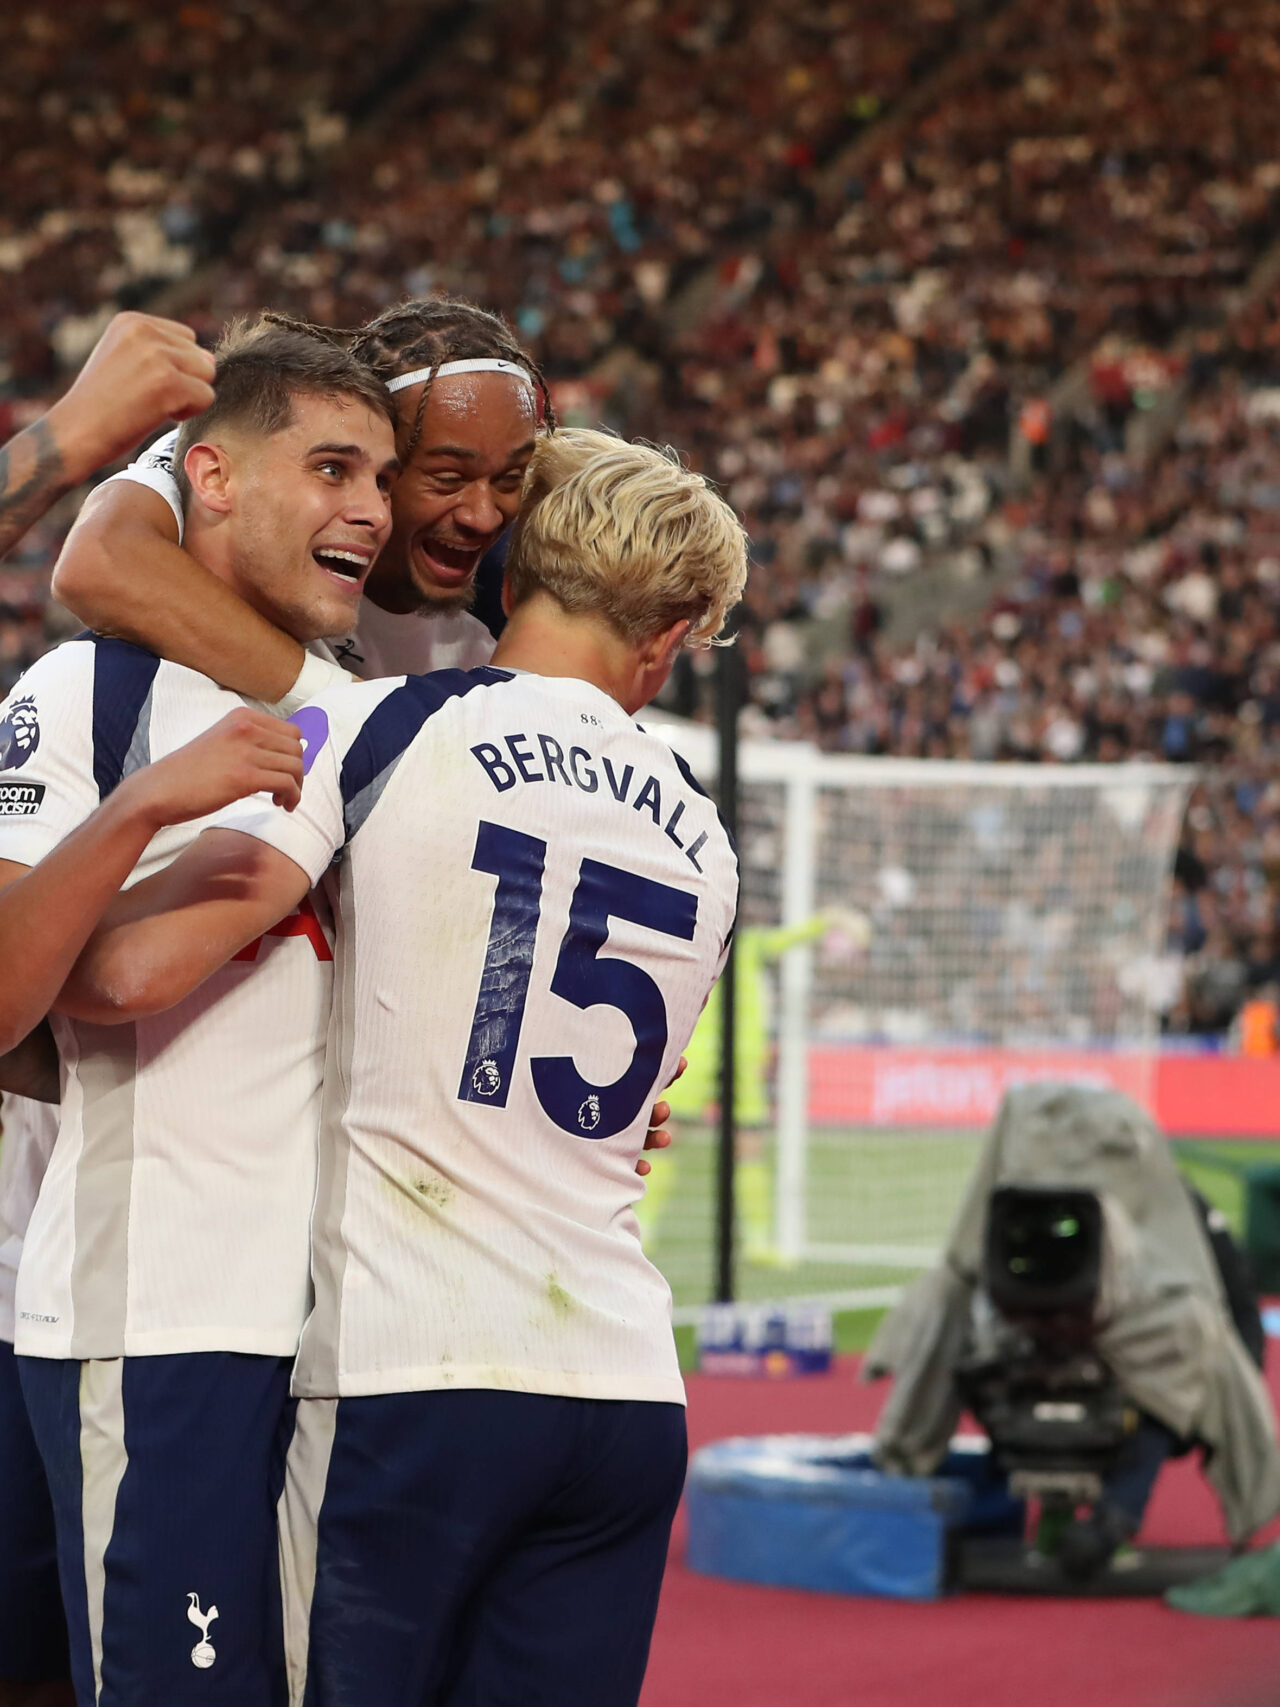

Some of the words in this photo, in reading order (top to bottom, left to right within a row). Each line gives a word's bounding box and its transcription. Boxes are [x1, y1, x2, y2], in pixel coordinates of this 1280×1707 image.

[580, 713, 604, 730] 88
[470, 733, 708, 873] BERGVALL
[457, 820, 699, 1139] 15
